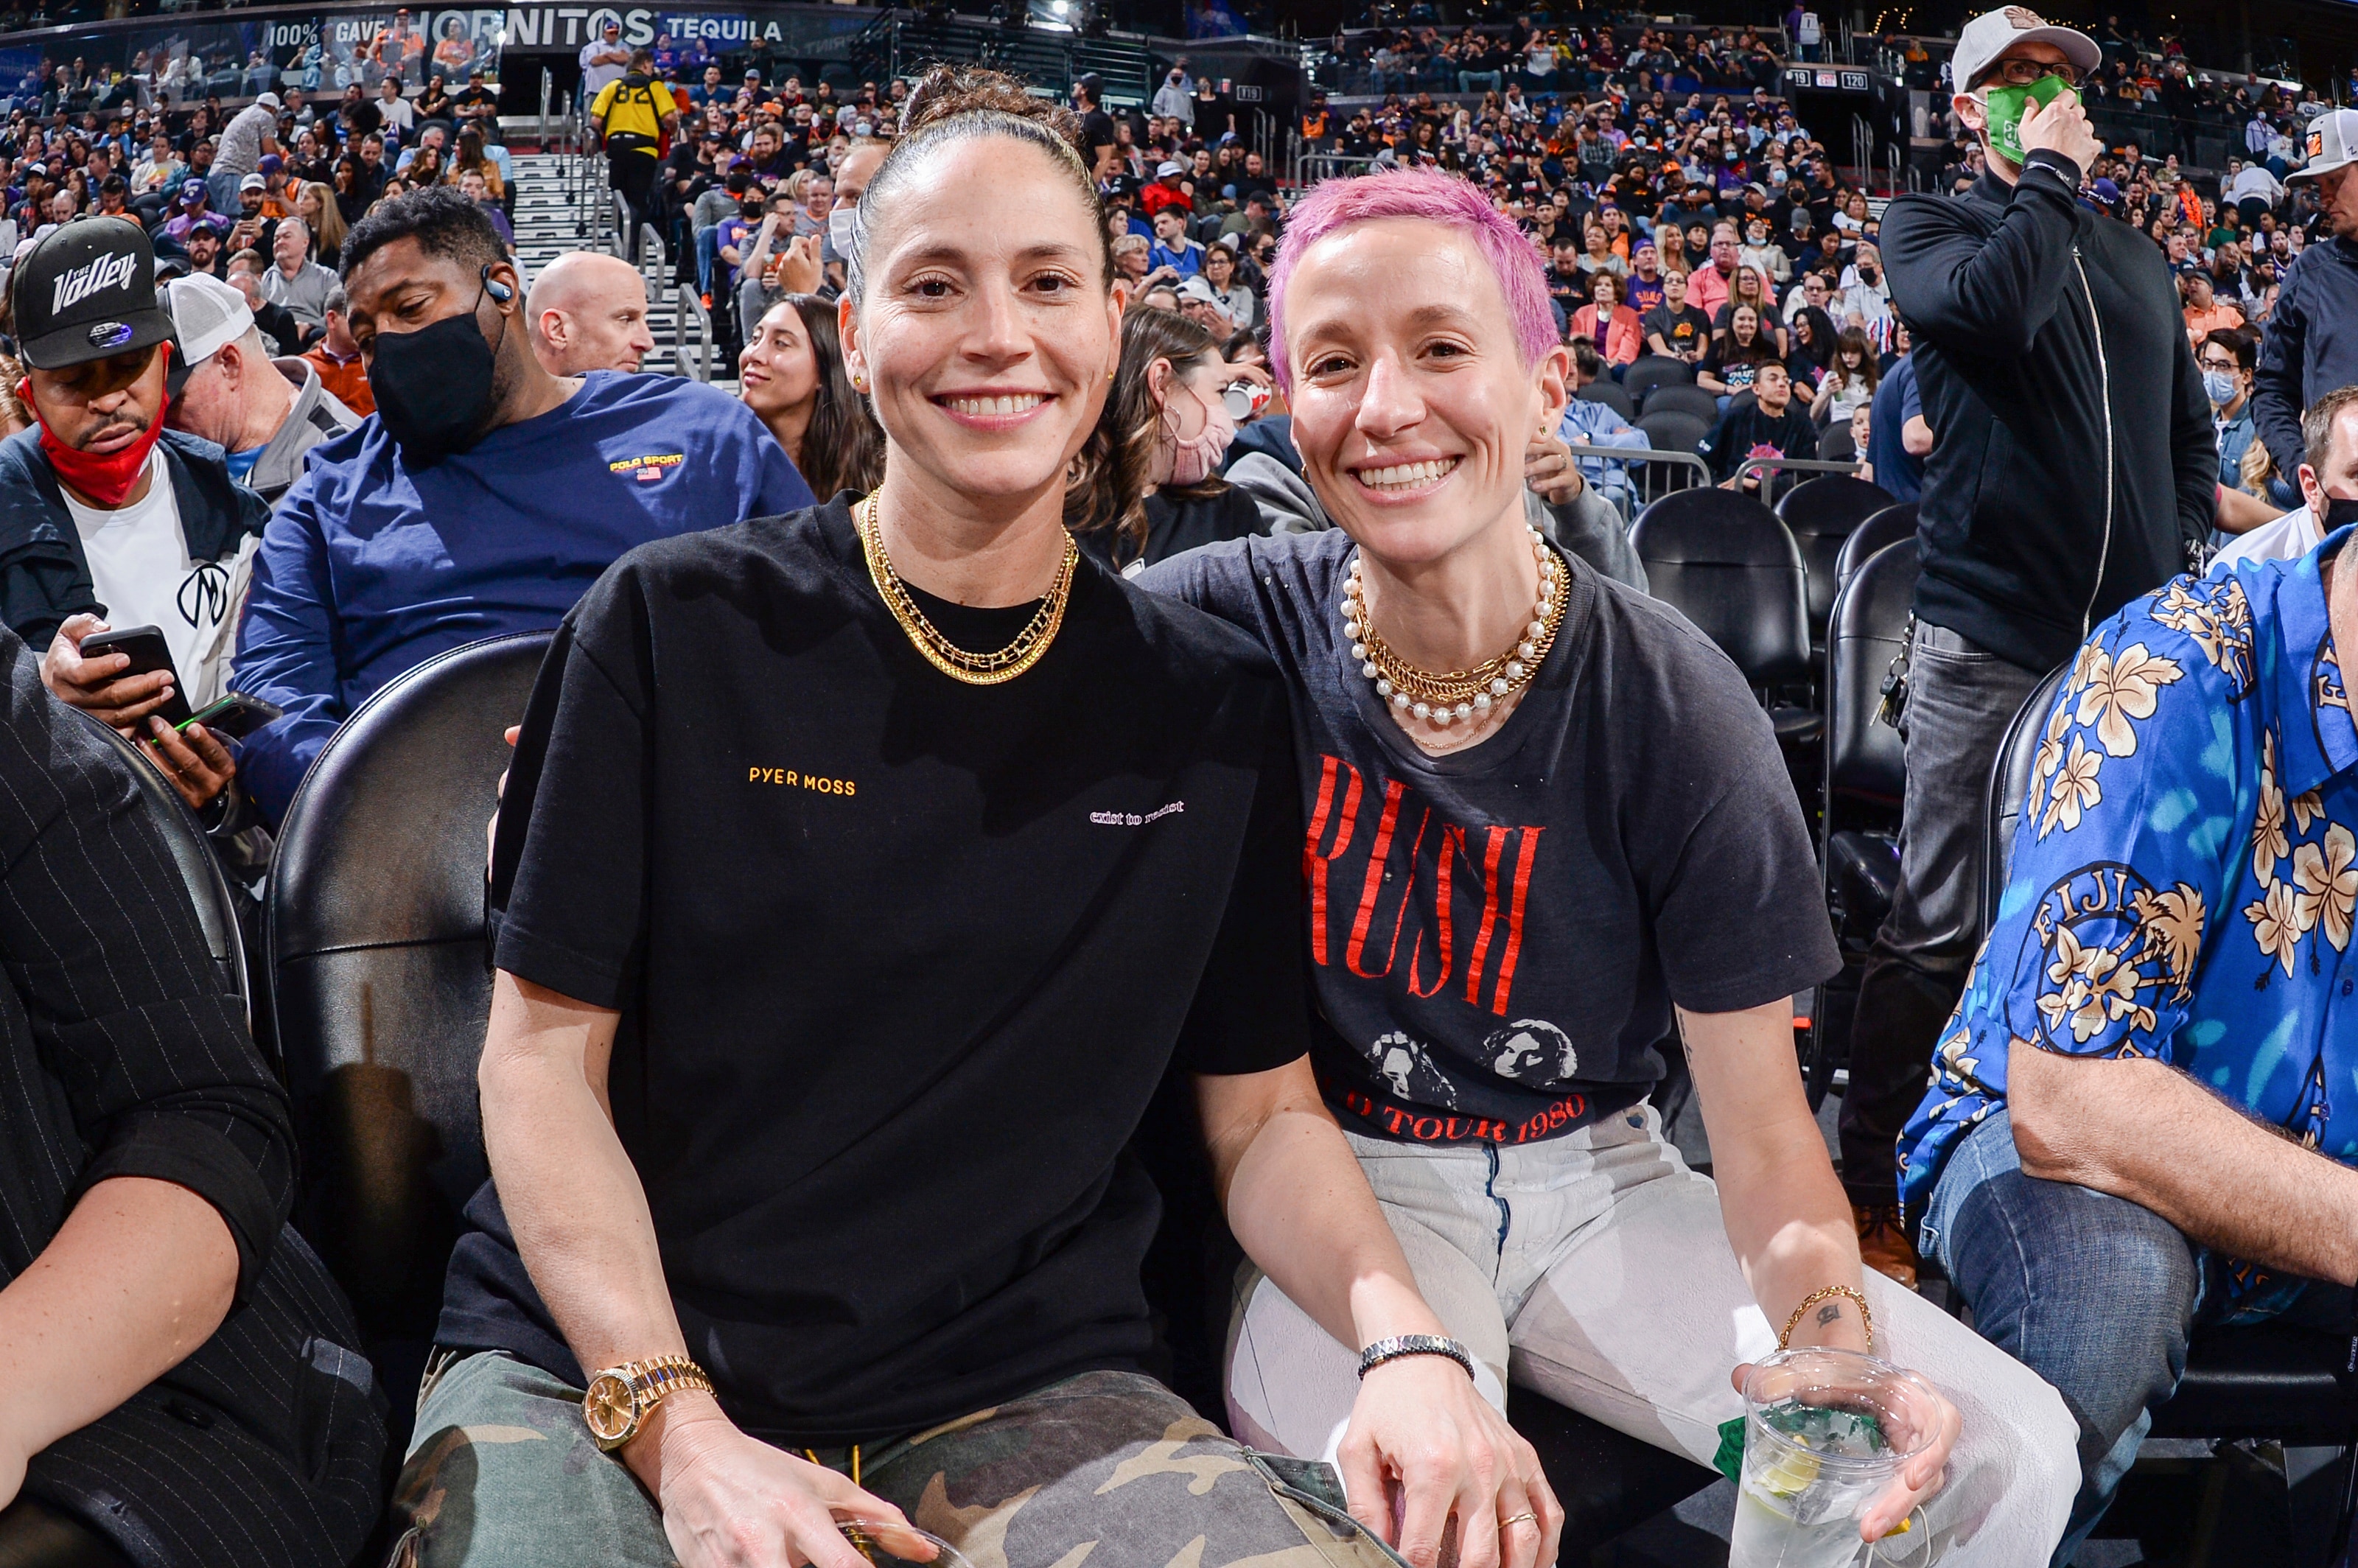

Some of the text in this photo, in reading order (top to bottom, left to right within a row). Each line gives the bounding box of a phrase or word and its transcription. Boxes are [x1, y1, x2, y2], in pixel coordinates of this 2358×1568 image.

[269, 24, 318, 46] 100%
[335, 21, 385, 42] GAVE
[666, 18, 783, 42] TEQUILA
[1794, 72, 1806, 84] 19
[1846, 74, 1864, 87] 120
[52, 251, 137, 315] Valley
[73, 265, 91, 279] THE
[609, 454, 683, 472] POLO SPORT
[749, 766, 856, 796] PYER MOSS
[1089, 800, 1185, 826] exist to resist
[1301, 753, 1547, 1018] RUSH
[2034, 870, 2128, 948] FIJI
[1382, 1093, 1585, 1144] TOUR 1980
